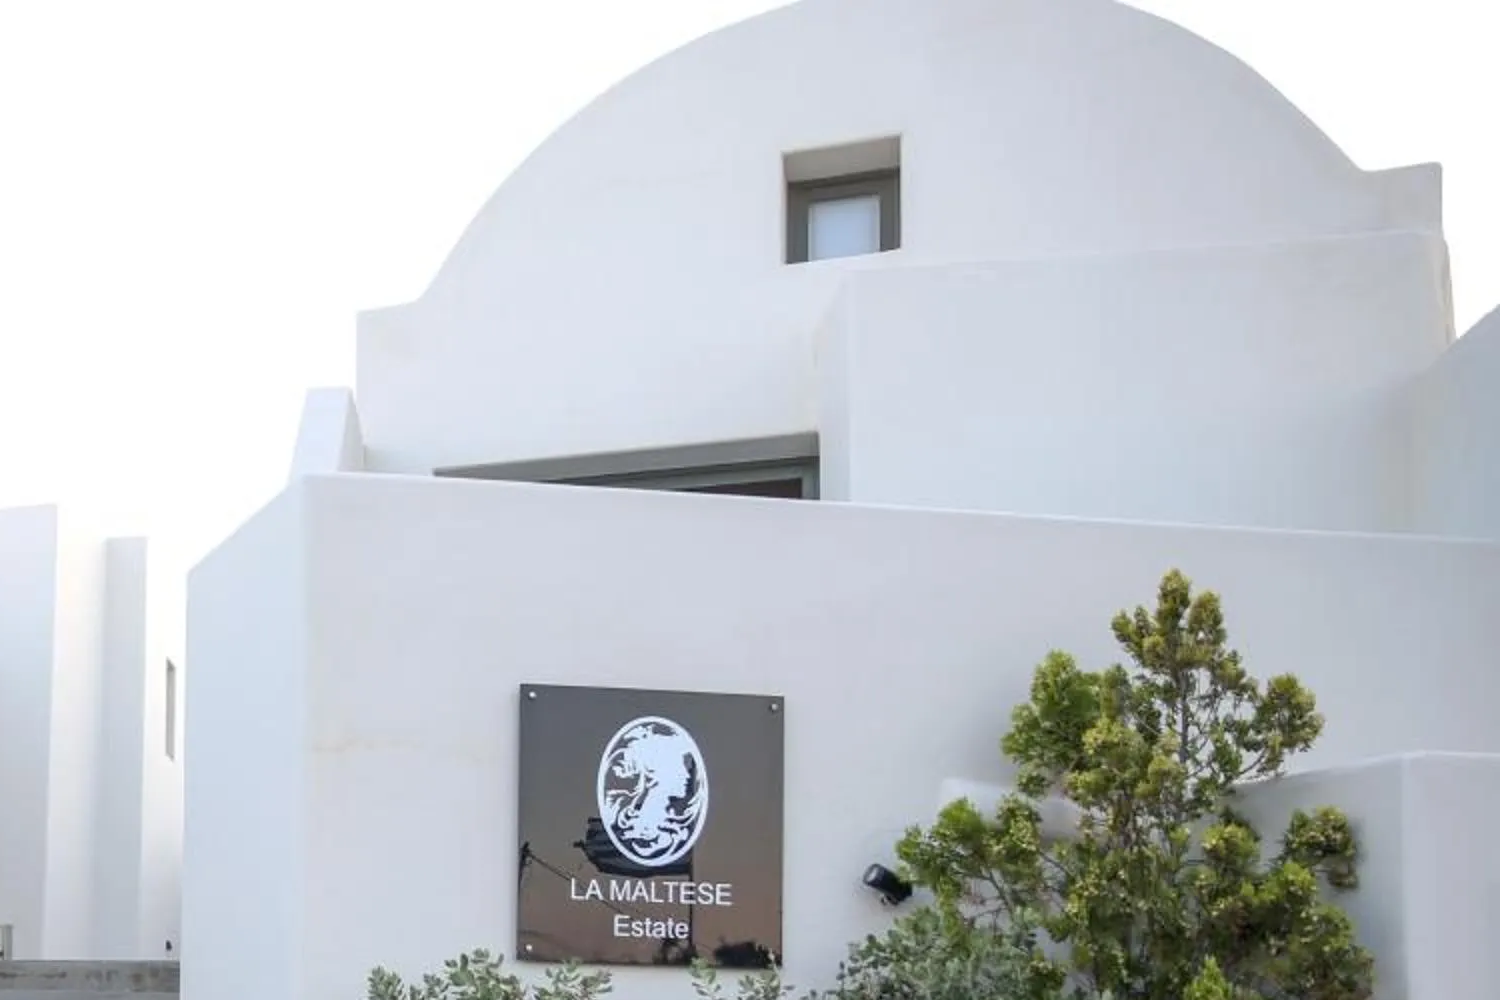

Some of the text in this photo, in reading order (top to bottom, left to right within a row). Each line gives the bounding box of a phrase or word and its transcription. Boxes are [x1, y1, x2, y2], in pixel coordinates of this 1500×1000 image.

[570, 878, 733, 906] LA MALTESE
[613, 914, 689, 939] Estate
